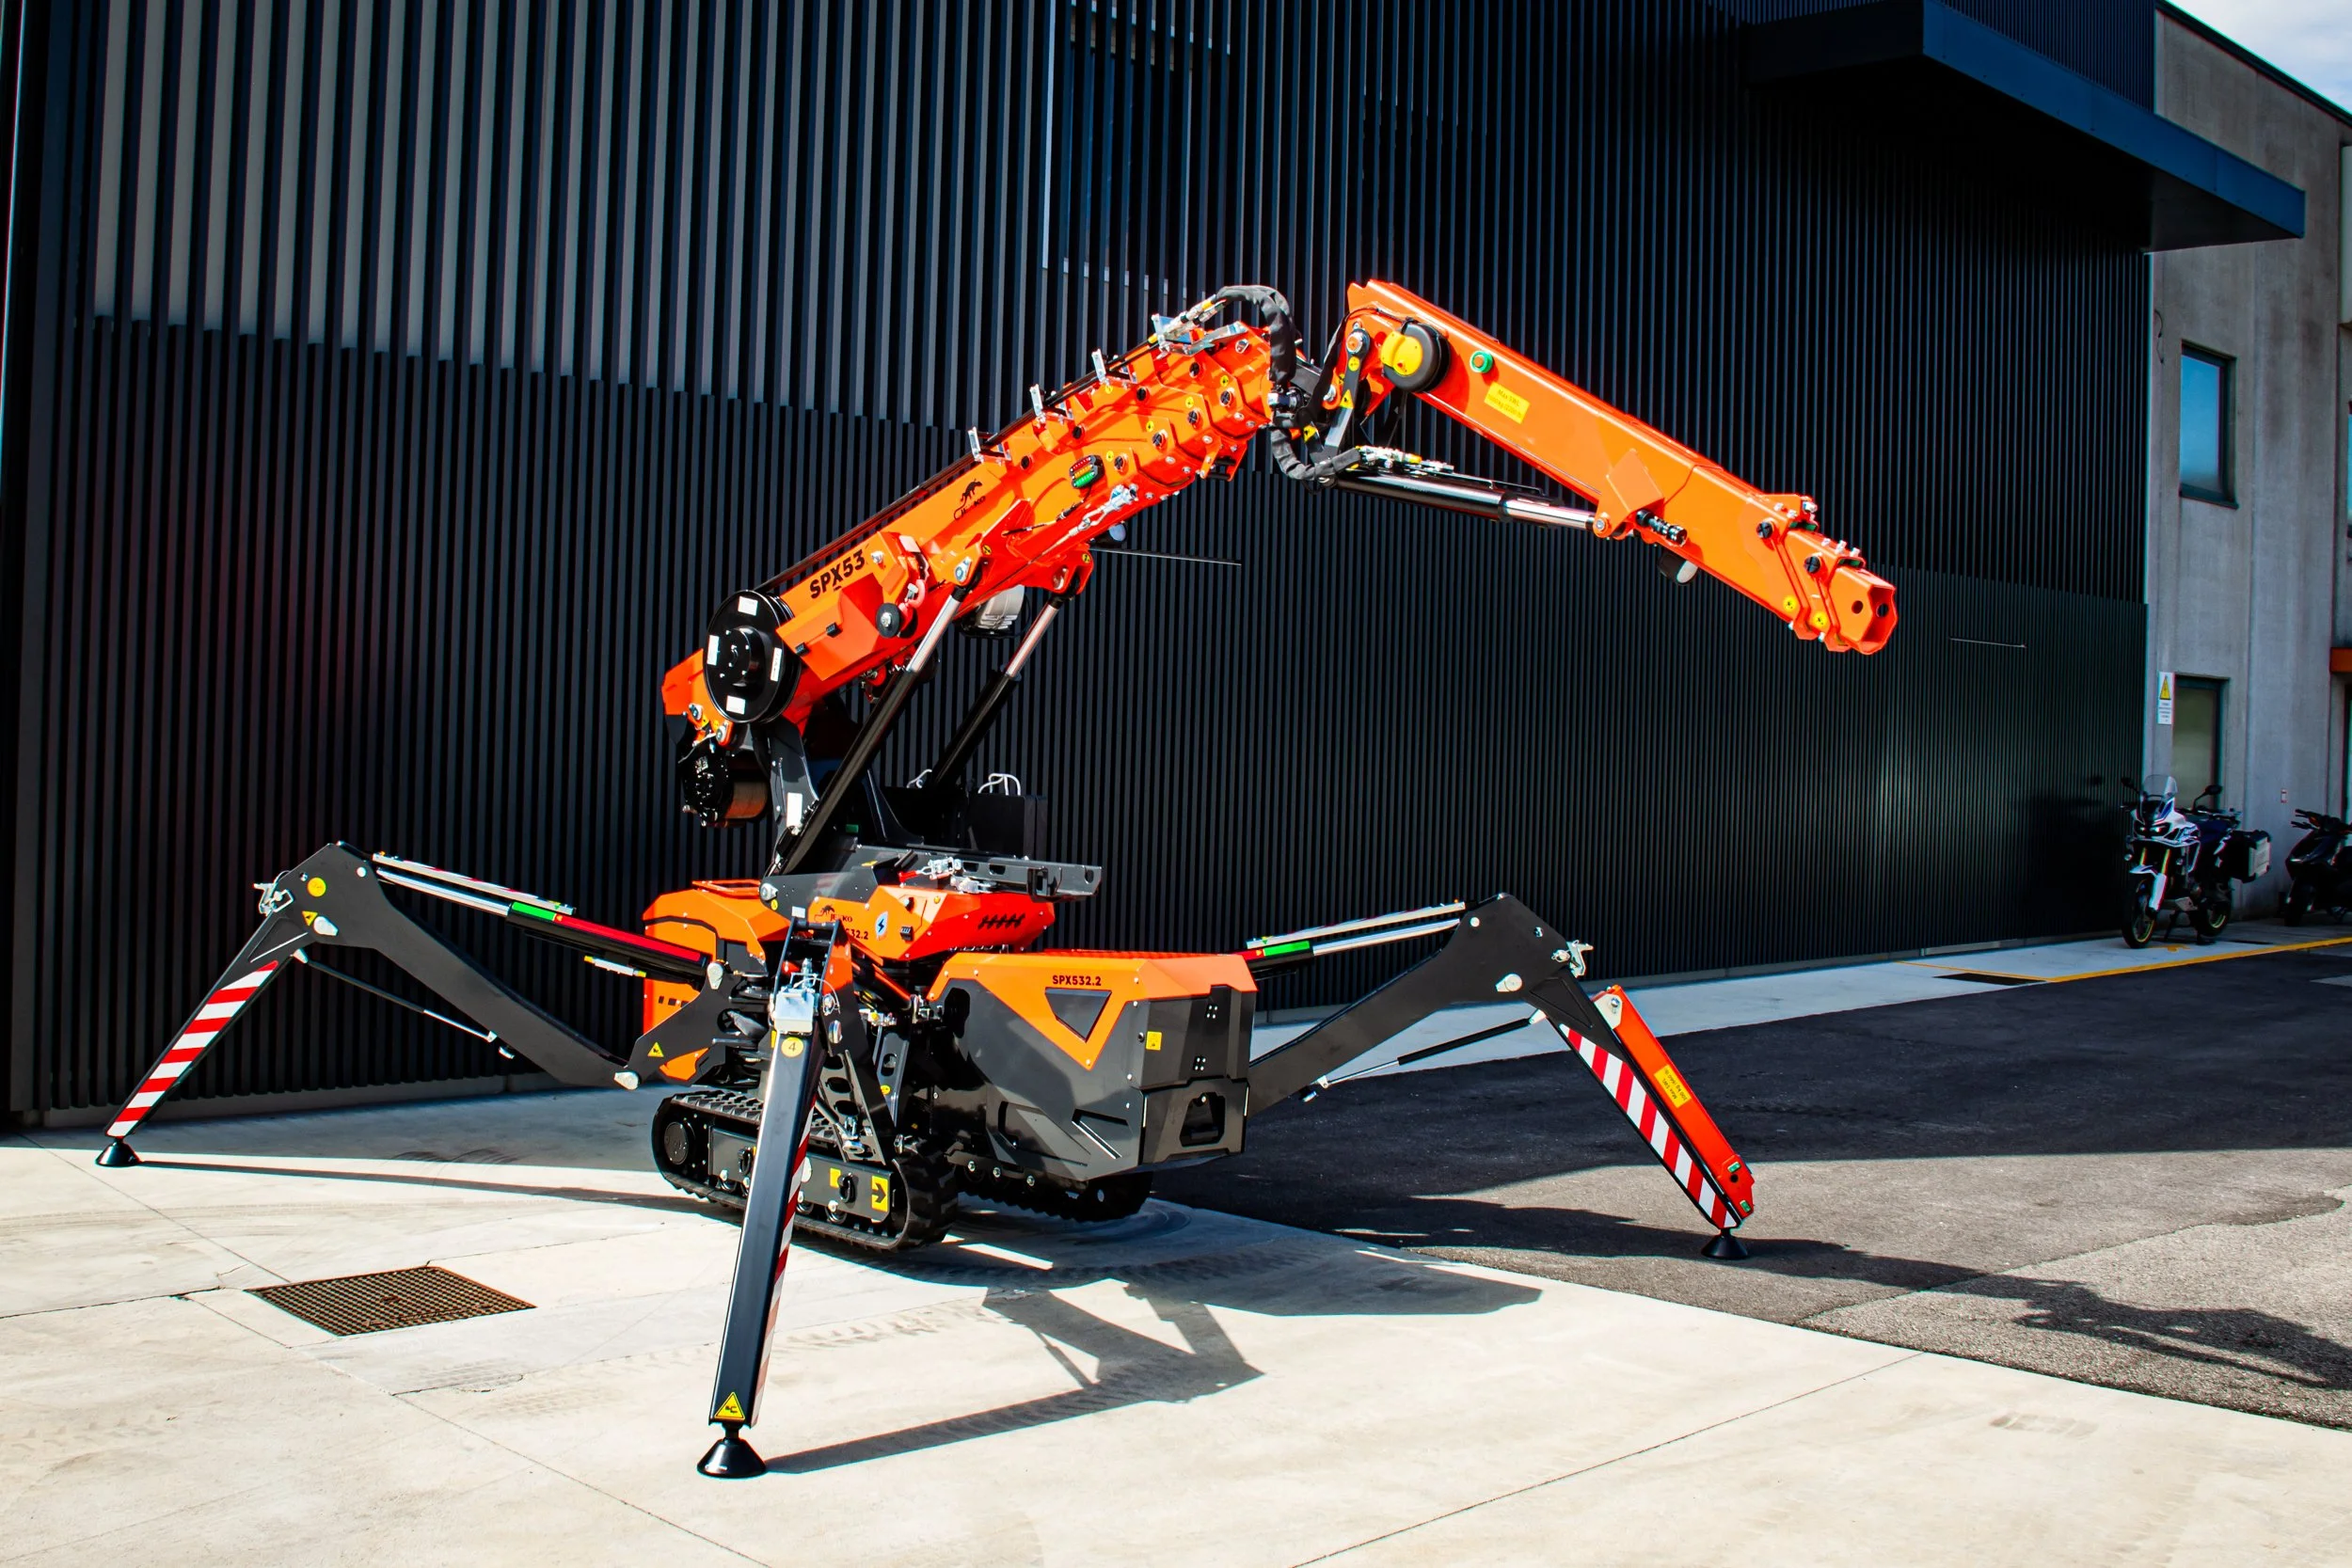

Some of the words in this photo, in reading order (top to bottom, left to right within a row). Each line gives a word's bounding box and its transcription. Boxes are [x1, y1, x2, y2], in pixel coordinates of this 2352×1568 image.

[810, 549, 865, 598] SPX53
[1052, 974, 1102, 986] SPX532.2
[788, 1041, 796, 1052] 4
